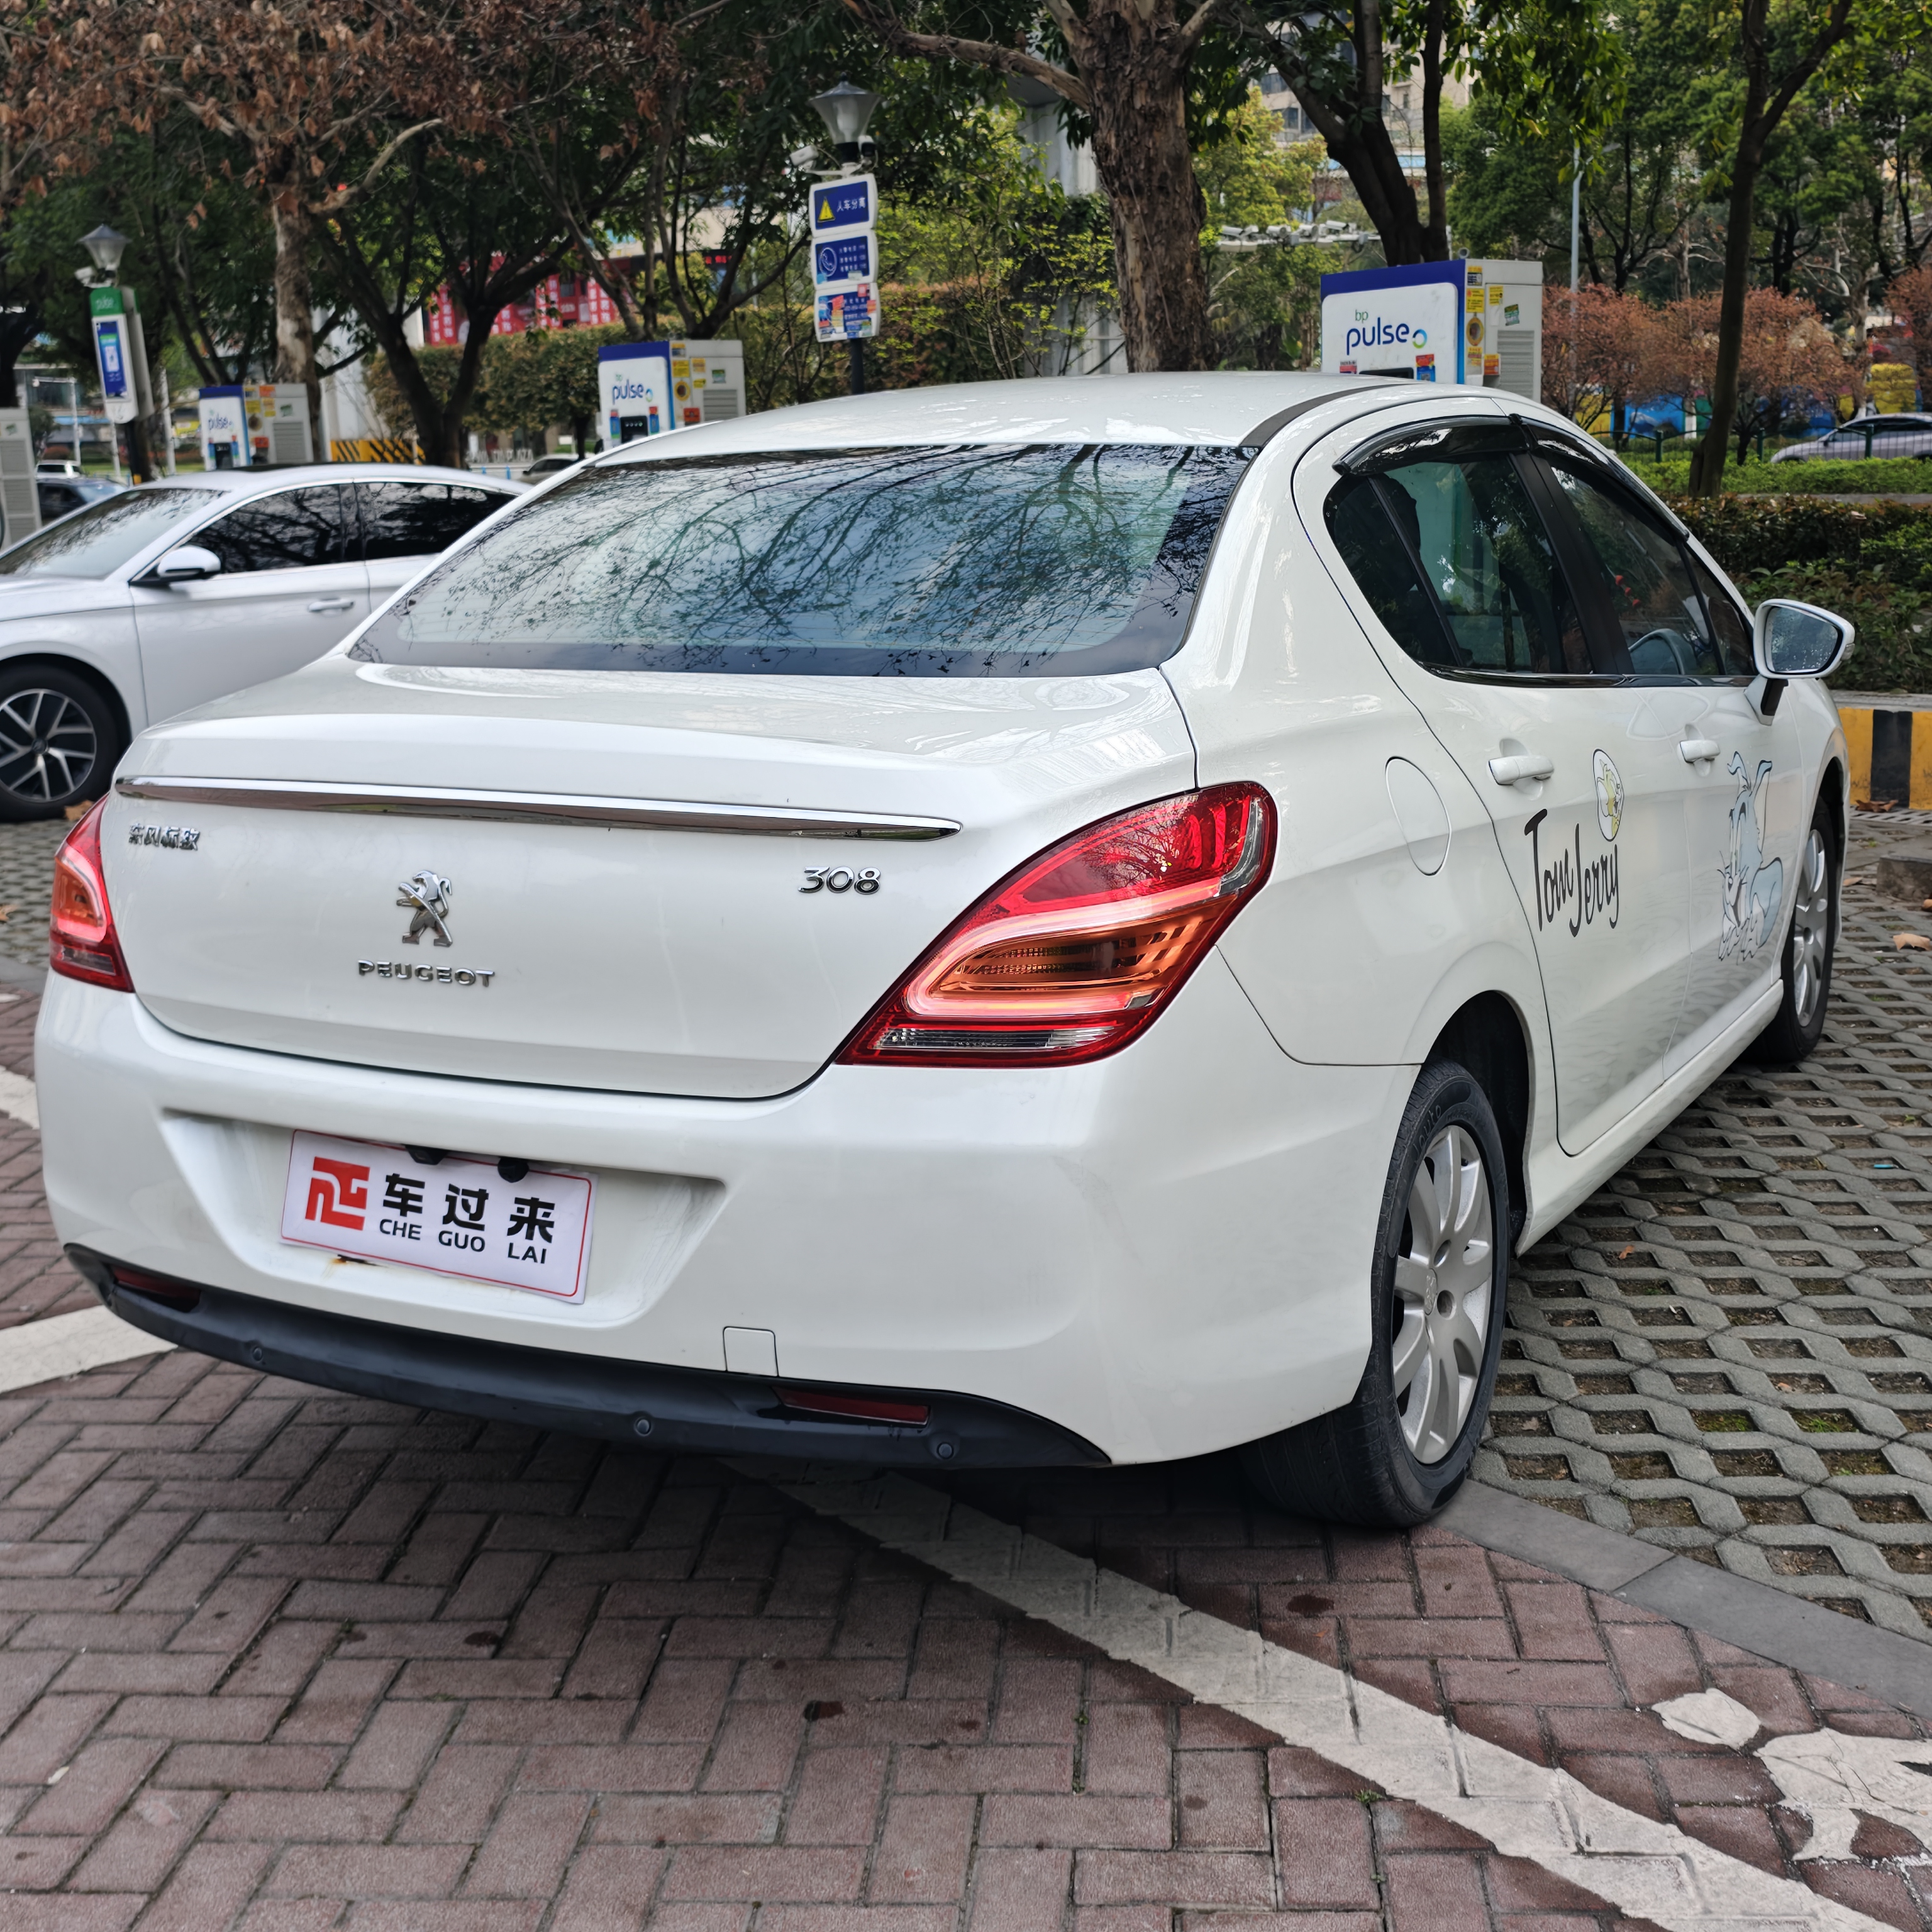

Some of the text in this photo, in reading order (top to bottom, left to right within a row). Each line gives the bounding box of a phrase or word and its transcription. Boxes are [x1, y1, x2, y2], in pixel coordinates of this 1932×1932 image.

[1355, 309, 1368, 323] bp
[1346, 317, 1409, 355] pulse
[613, 379, 644, 405] pulse
[798, 866, 881, 895] 308
[1569, 823, 1619, 937] Jerry
[358, 960, 495, 987] PEUGEOT
[379, 1219, 547, 1264] CHE GUO LAI
